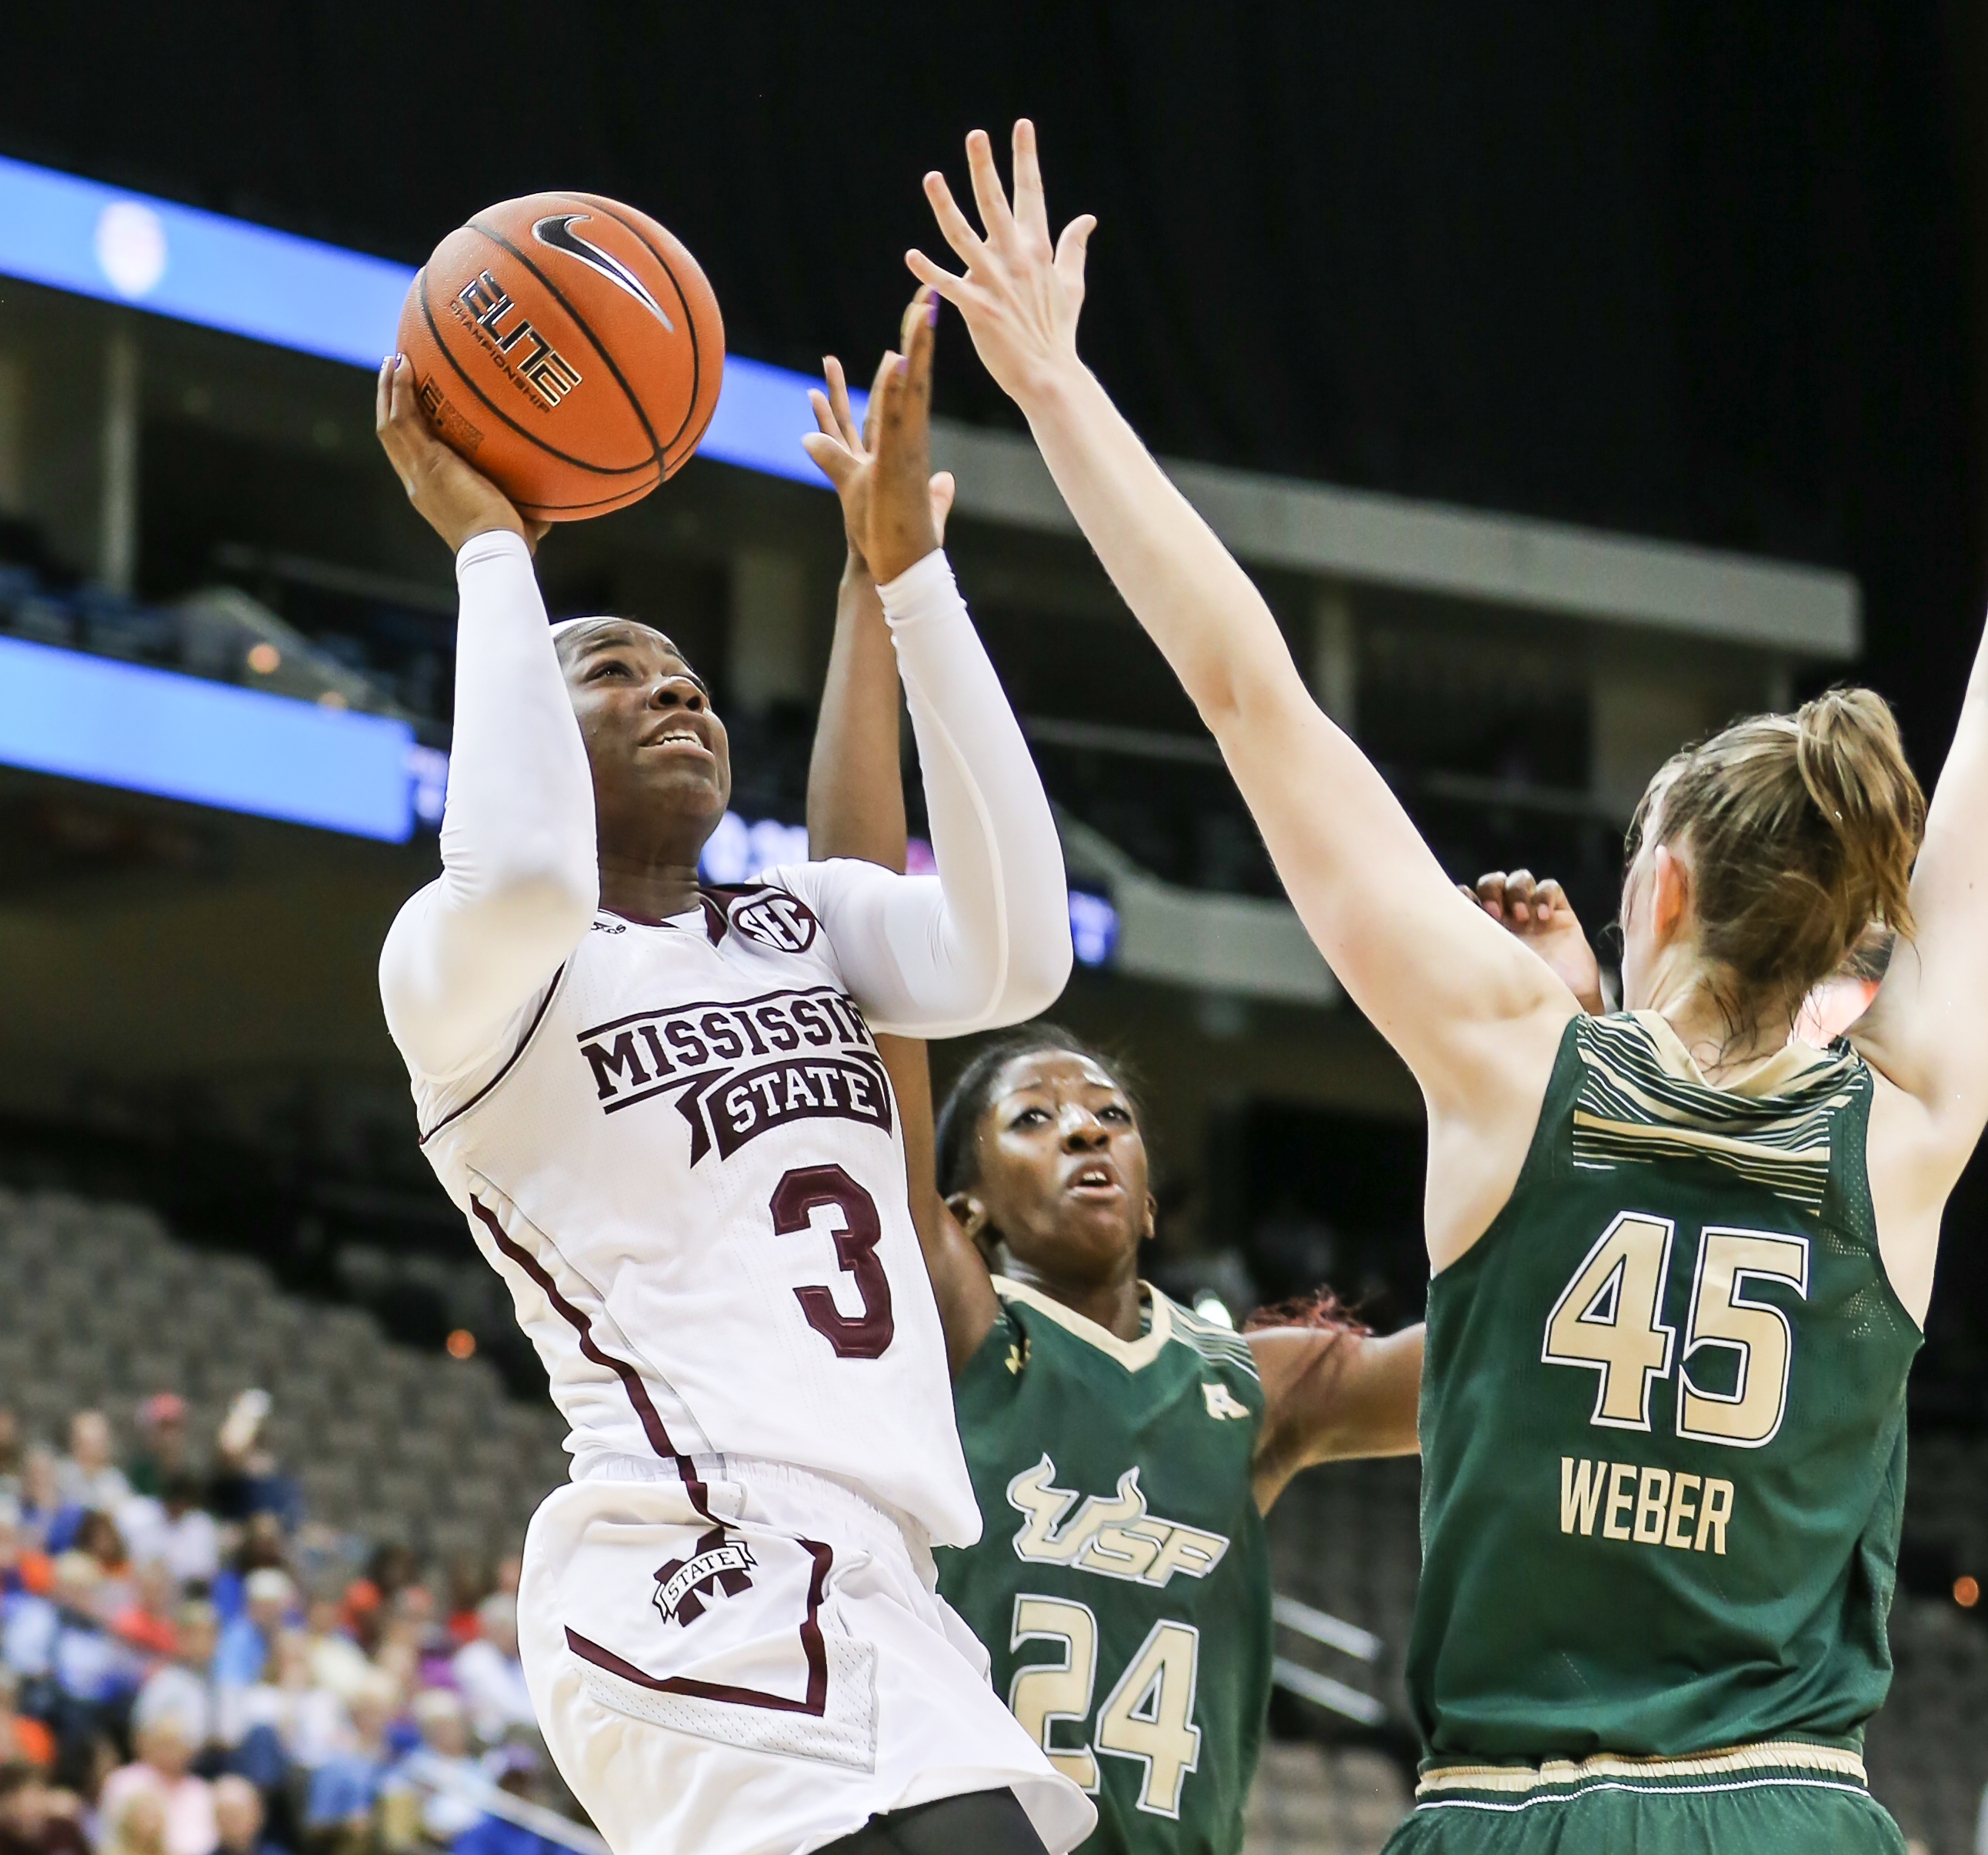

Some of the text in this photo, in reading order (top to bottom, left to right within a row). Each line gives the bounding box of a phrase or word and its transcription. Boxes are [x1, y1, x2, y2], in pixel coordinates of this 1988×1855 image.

[450, 300, 550, 413] CHAMPIONSHIP
[457, 269, 582, 407] ELITE
[738, 899, 810, 949] SEC
[581, 998, 874, 1100] MISSISSIP
[725, 1066, 879, 1133] STATE
[769, 1163, 894, 1360] 3
[1541, 1210, 1810, 1449] 45
[1006, 1452, 1230, 1588] USF
[1561, 1456, 1734, 1555] WEBER
[668, 1551, 735, 1601] STATE
[1009, 1593, 1202, 1820] 24
